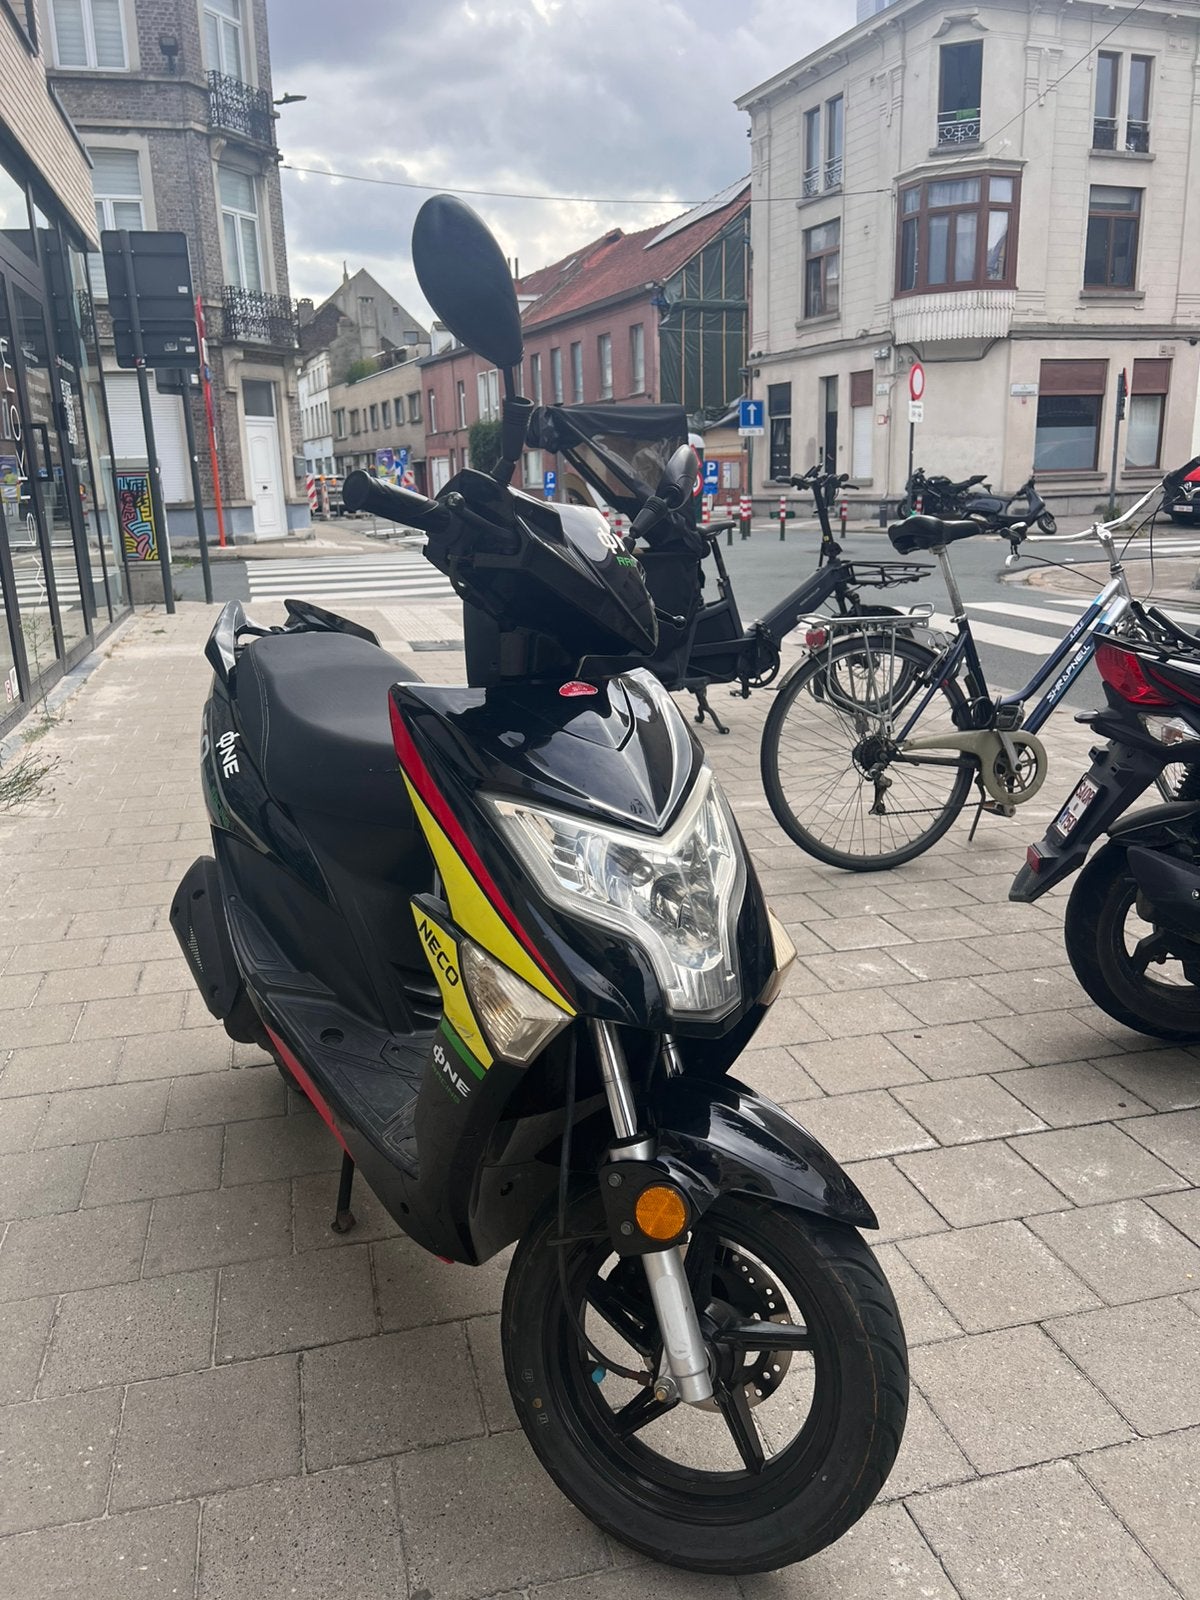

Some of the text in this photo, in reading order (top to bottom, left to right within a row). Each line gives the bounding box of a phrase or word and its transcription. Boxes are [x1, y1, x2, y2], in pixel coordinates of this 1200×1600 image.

[547, 471, 554, 483] P
[706, 462, 716, 475] P
[1046, 645, 1090, 703] SHRAPNELL
[418, 919, 459, 987] NECO
